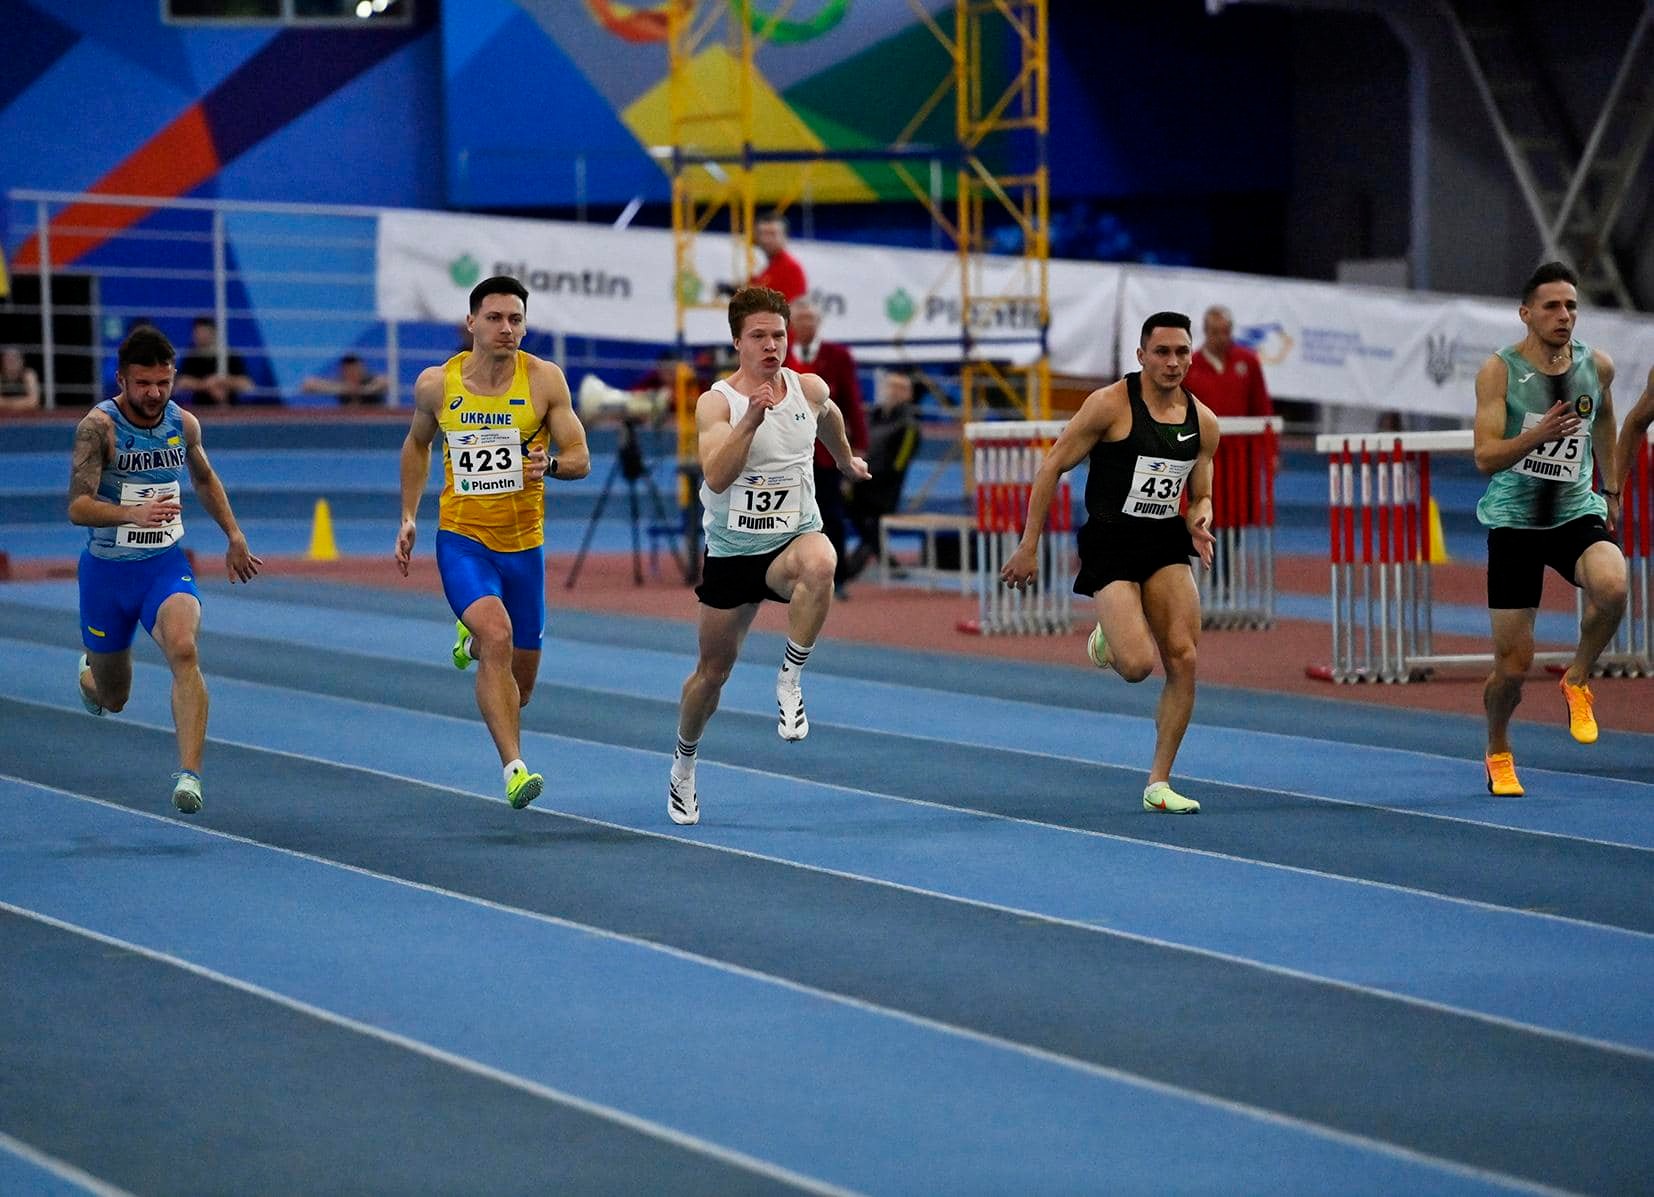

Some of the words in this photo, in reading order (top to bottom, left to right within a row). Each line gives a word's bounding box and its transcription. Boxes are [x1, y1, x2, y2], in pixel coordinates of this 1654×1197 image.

[925, 294, 1049, 329] Planti
[461, 412, 512, 425] UKRAINE
[117, 447, 185, 473] UKRAINE
[459, 447, 512, 473] 423
[1523, 458, 1562, 477] PUMA
[472, 479, 516, 491] Plantin
[1140, 477, 1183, 499] 433
[744, 489, 790, 513] 137
[1133, 501, 1168, 516] PUMA
[738, 515, 775, 530] PUMA
[127, 530, 164, 545] PUMA
